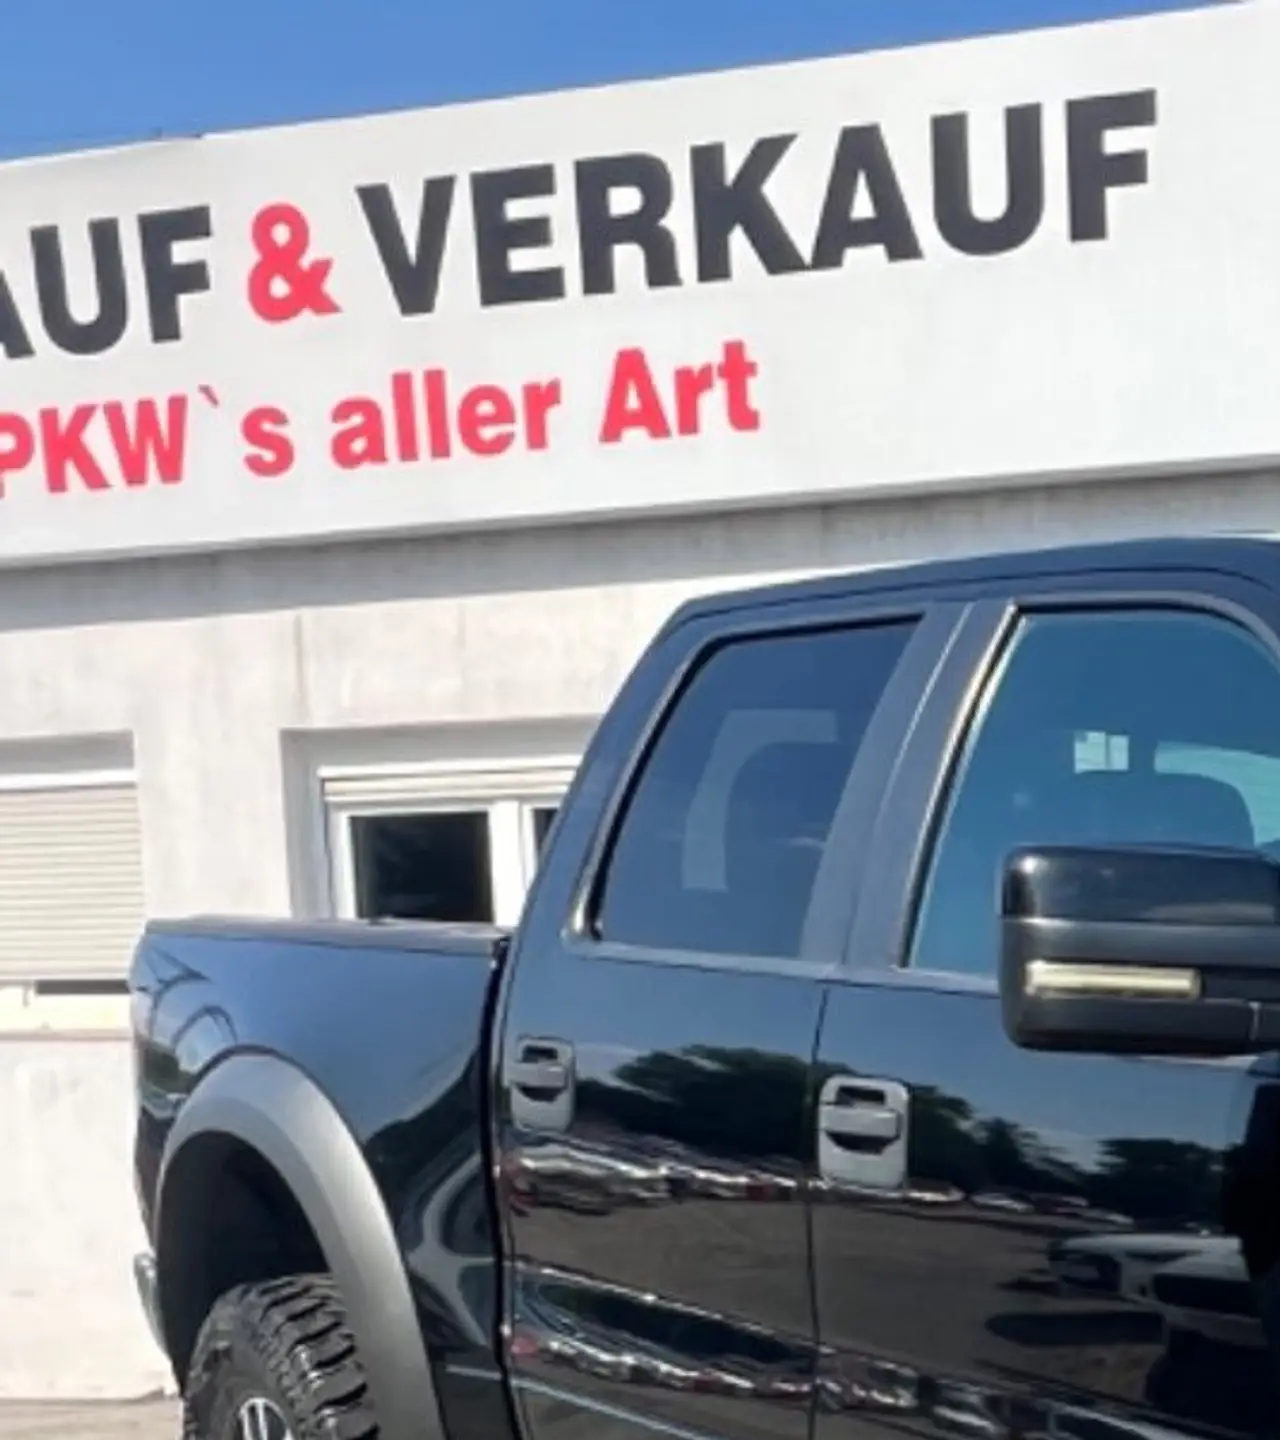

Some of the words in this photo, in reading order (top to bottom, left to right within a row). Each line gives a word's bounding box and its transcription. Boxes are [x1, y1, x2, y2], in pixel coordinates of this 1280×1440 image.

[247, 203, 343, 324] &
[356, 89, 1158, 316] VERKAUF
[330, 368, 561, 470] aller
[599, 340, 760, 443] Art
